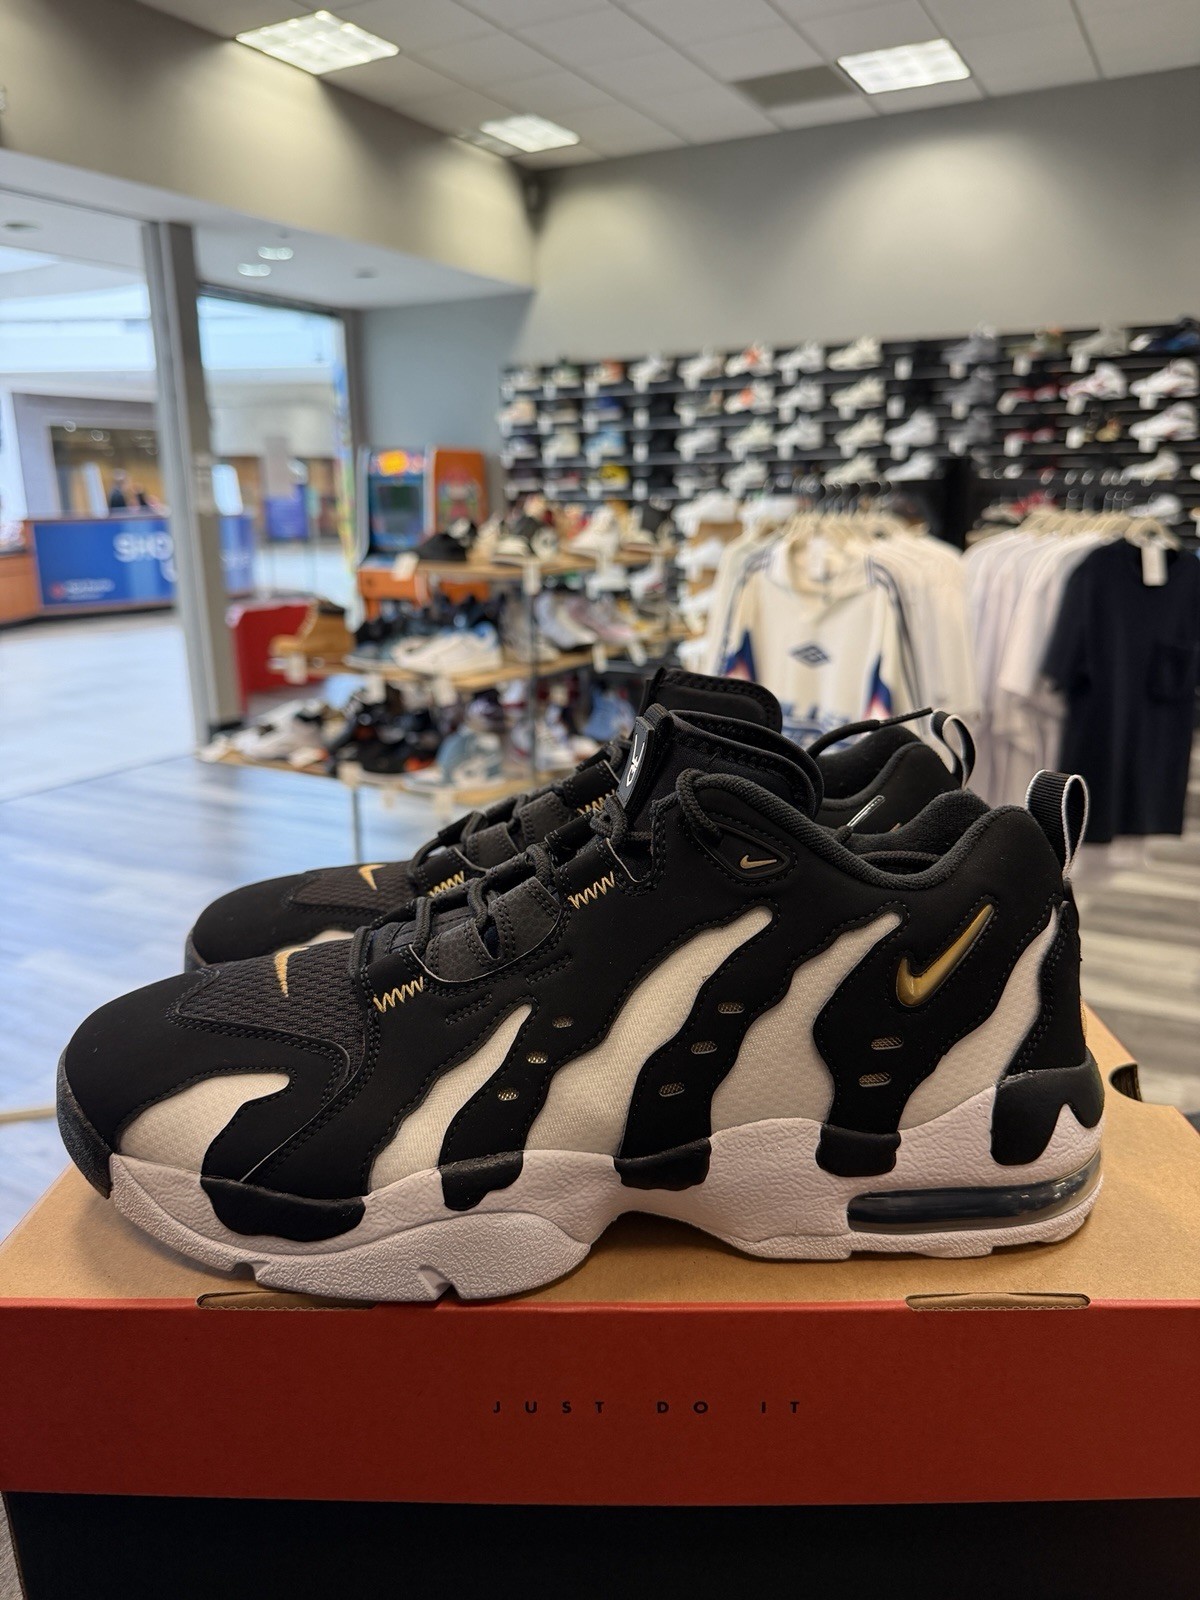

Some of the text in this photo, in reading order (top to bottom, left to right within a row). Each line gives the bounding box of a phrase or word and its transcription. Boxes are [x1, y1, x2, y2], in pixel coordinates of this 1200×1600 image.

[492, 1401, 801, 1415] JUST DO IT
